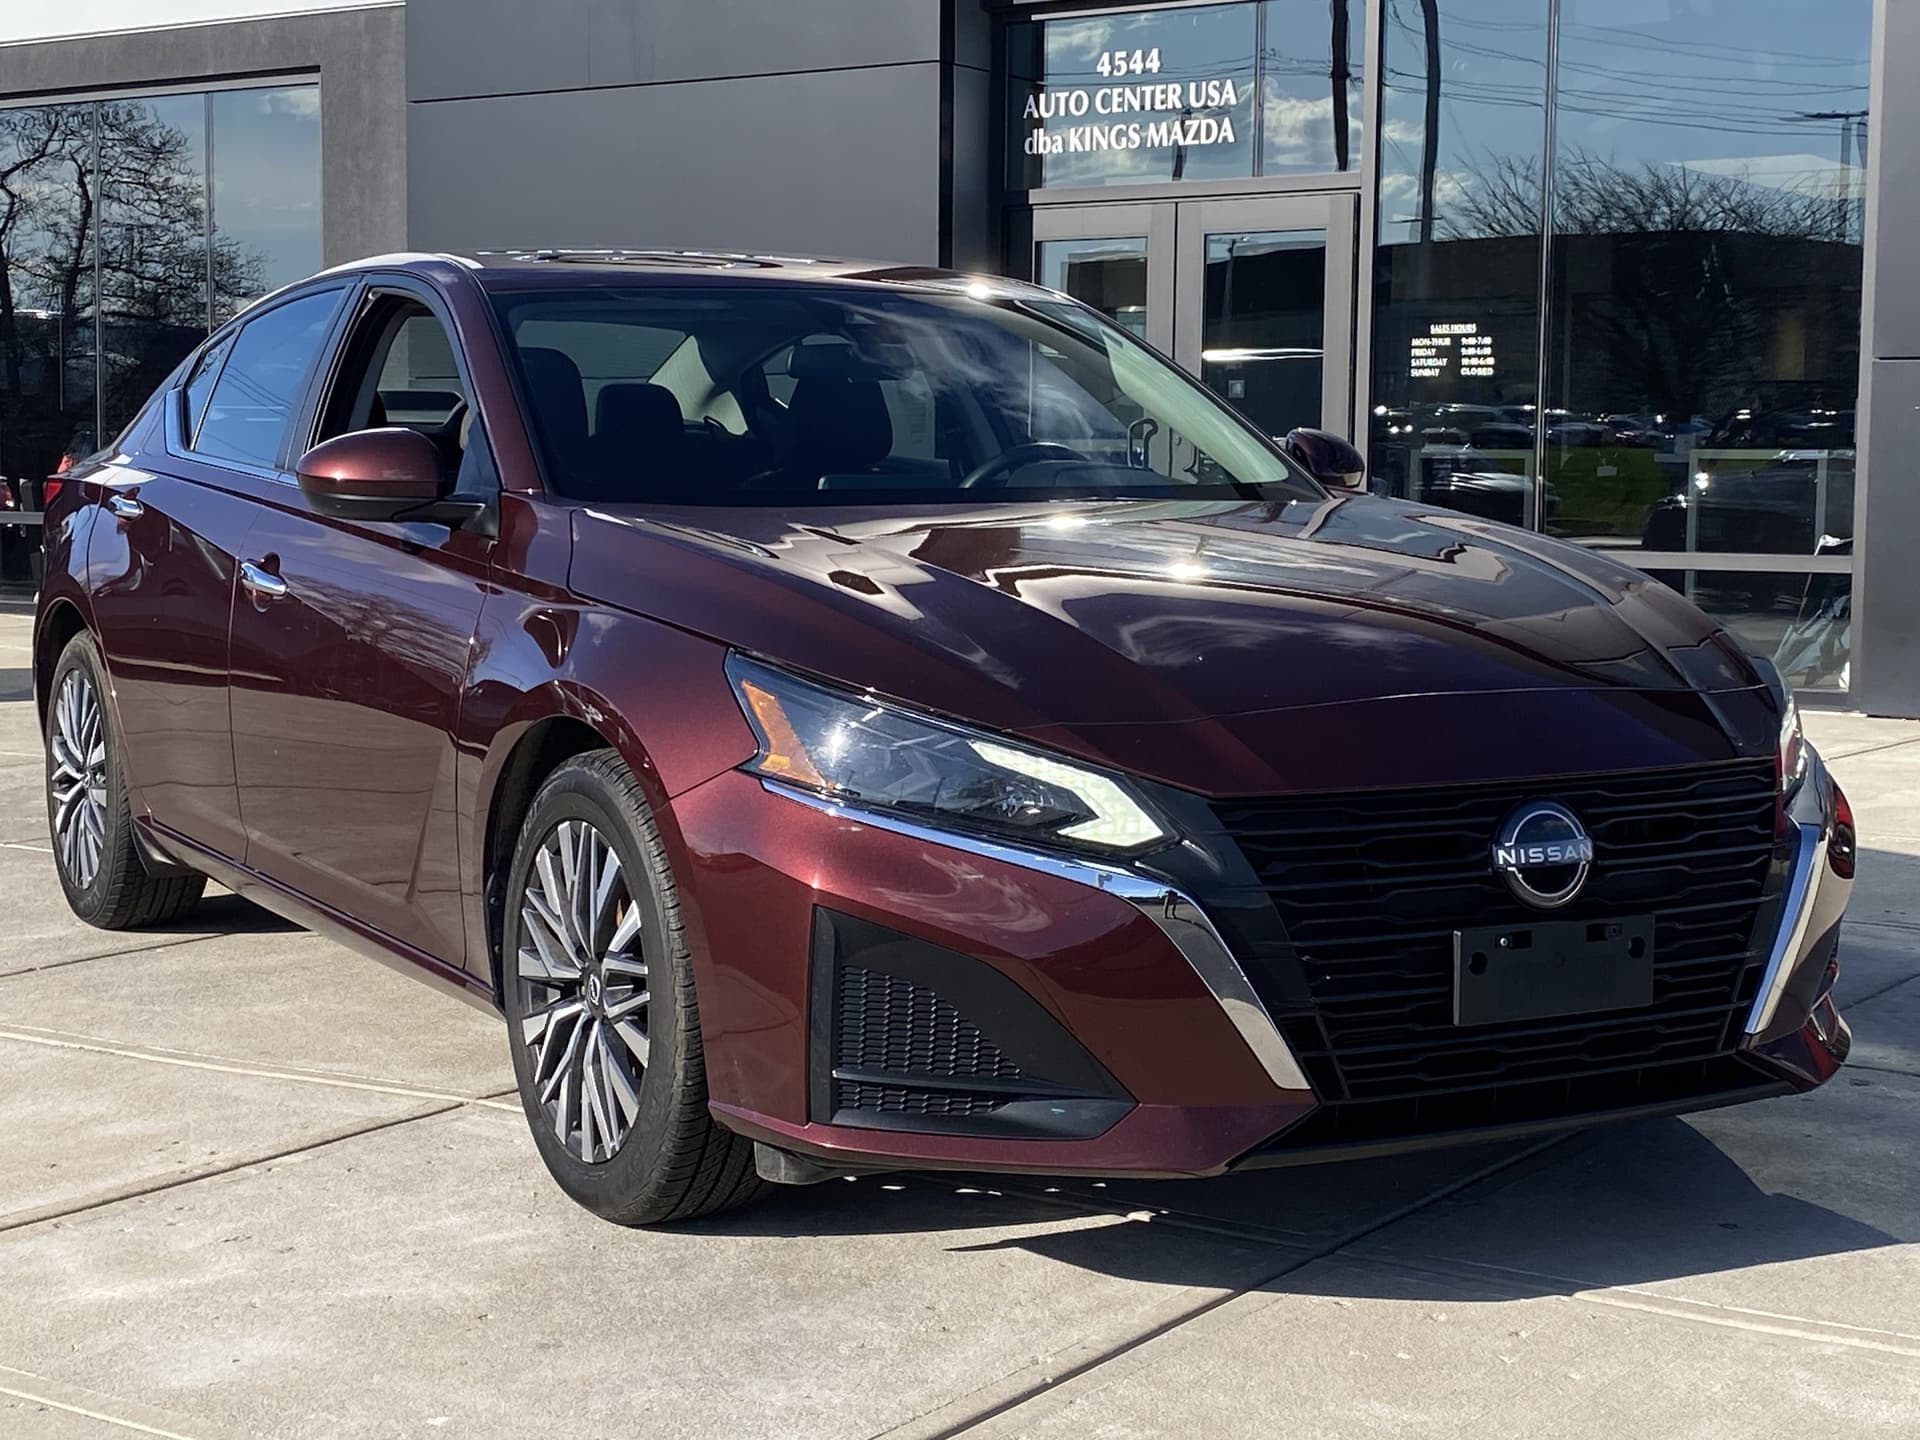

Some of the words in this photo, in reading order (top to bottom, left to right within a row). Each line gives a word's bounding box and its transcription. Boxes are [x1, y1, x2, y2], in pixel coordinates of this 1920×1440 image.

[1097, 48, 1160, 76] 4544
[1023, 90, 1088, 118] AUTO
[1095, 84, 1182, 113] CENTER
[1189, 79, 1237, 108] USA
[1024, 128, 1063, 154] dba
[1069, 123, 1140, 151] KINGS
[1146, 117, 1235, 148] MAZDA
[1430, 324, 1449, 334] SALES
[1451, 323, 1477, 333] HOURS
[1411, 348, 1436, 356] FRIDAY
[1411, 358, 1448, 367] SATURDAY
[1411, 368, 1440, 377] SUNDAY
[1461, 367, 1494, 376] CLOSED
[1497, 843, 1592, 864] NISSAN
